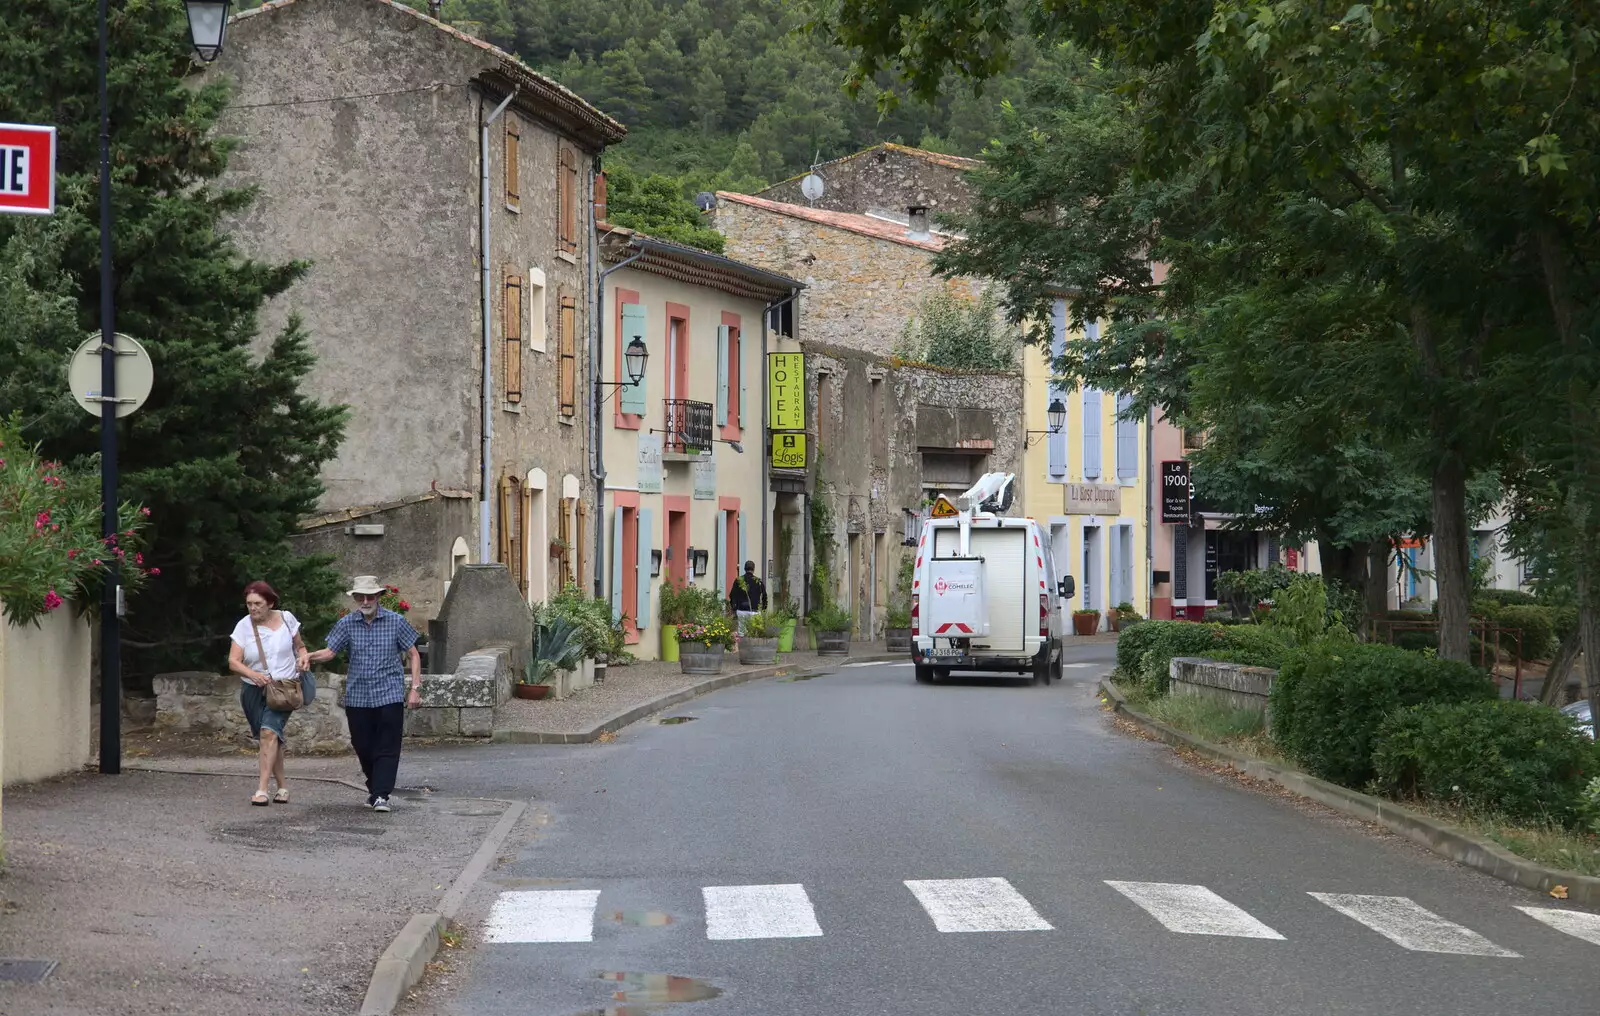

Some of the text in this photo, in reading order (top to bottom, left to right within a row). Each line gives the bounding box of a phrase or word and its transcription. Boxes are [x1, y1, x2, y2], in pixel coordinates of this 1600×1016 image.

[774, 355, 787, 426] HOTEL
[774, 448, 804, 466] Logis
[1171, 464, 1181, 472] Le
[1163, 475, 1187, 486] 1900
